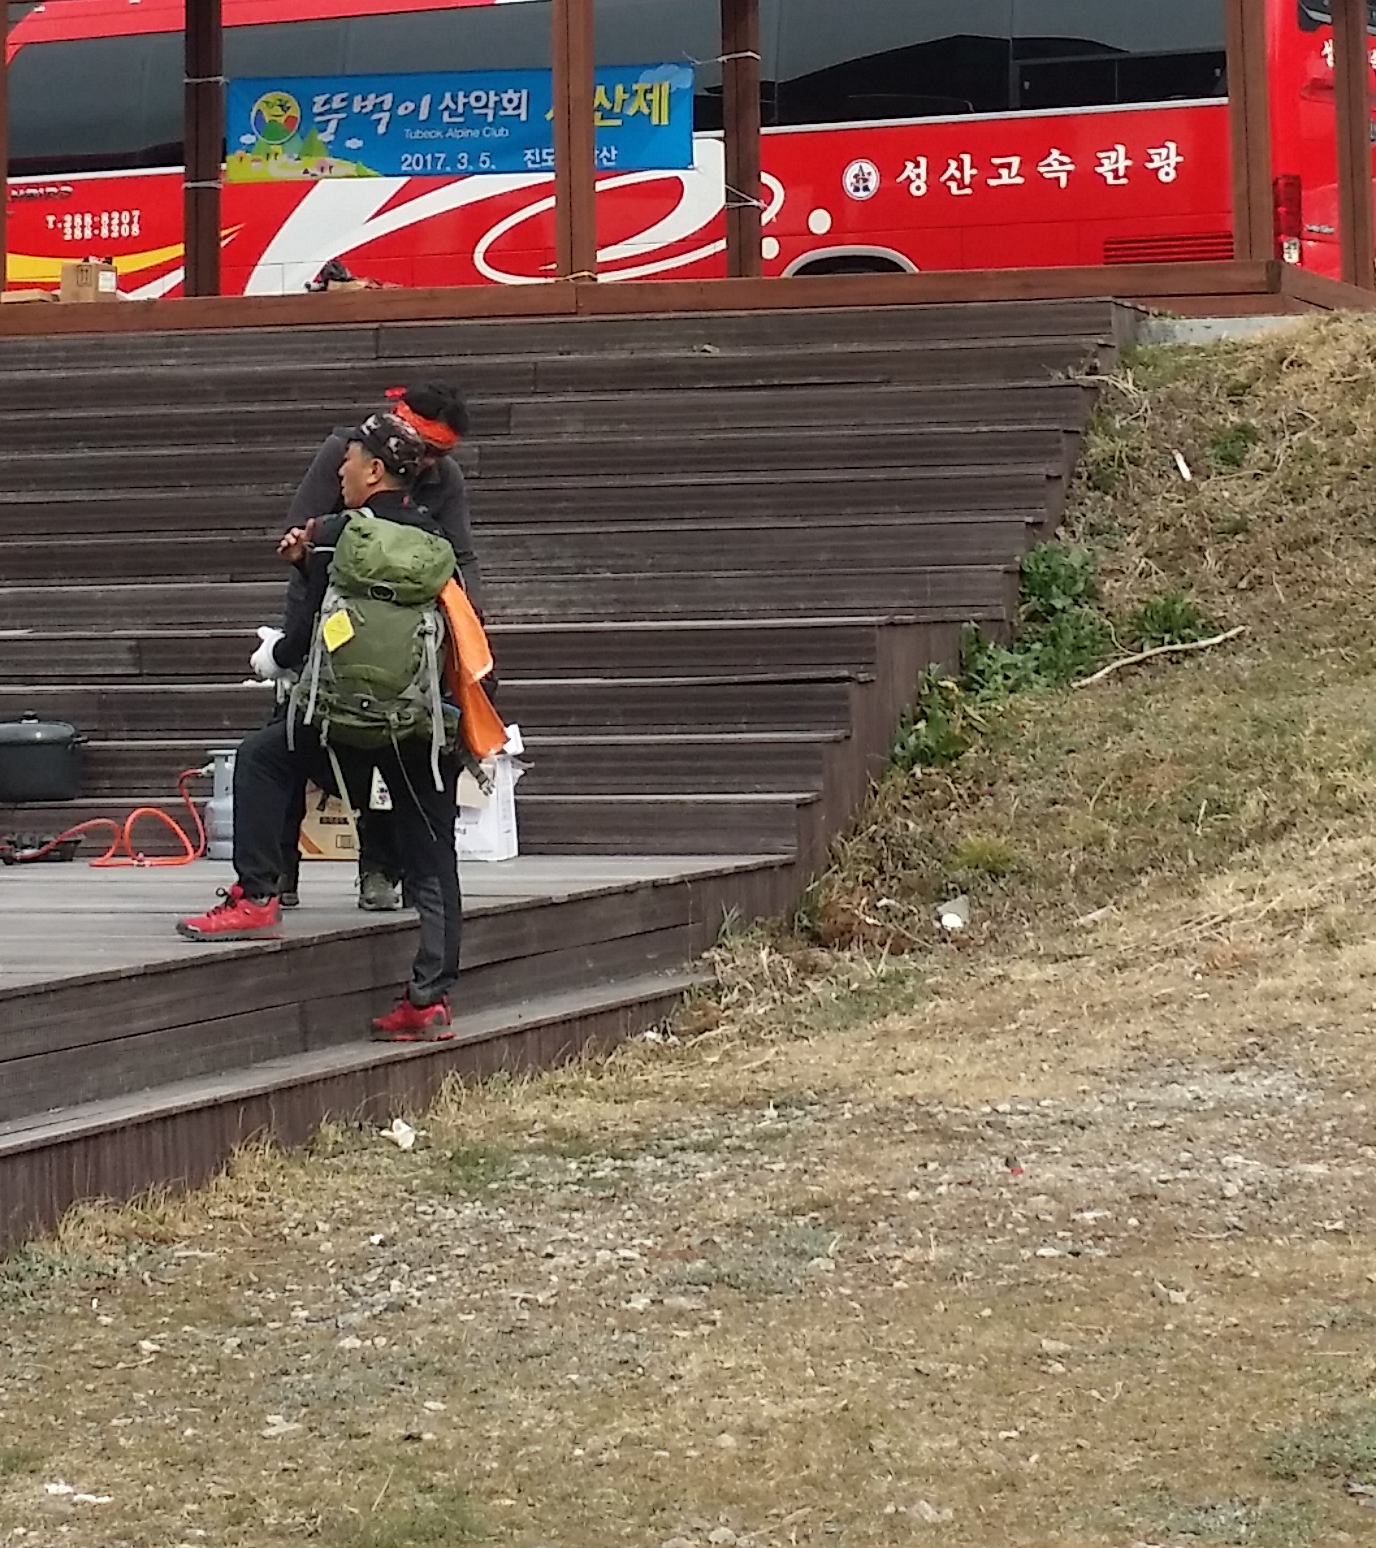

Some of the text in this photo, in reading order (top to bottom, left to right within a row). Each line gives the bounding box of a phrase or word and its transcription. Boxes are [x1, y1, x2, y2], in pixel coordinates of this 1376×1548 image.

[311, 81, 670, 143] 뚜벅이 산악회 산제
[446, 127, 480, 139] Alpine
[482, 126, 510, 137] Club
[400, 153, 452, 172] 2017.
